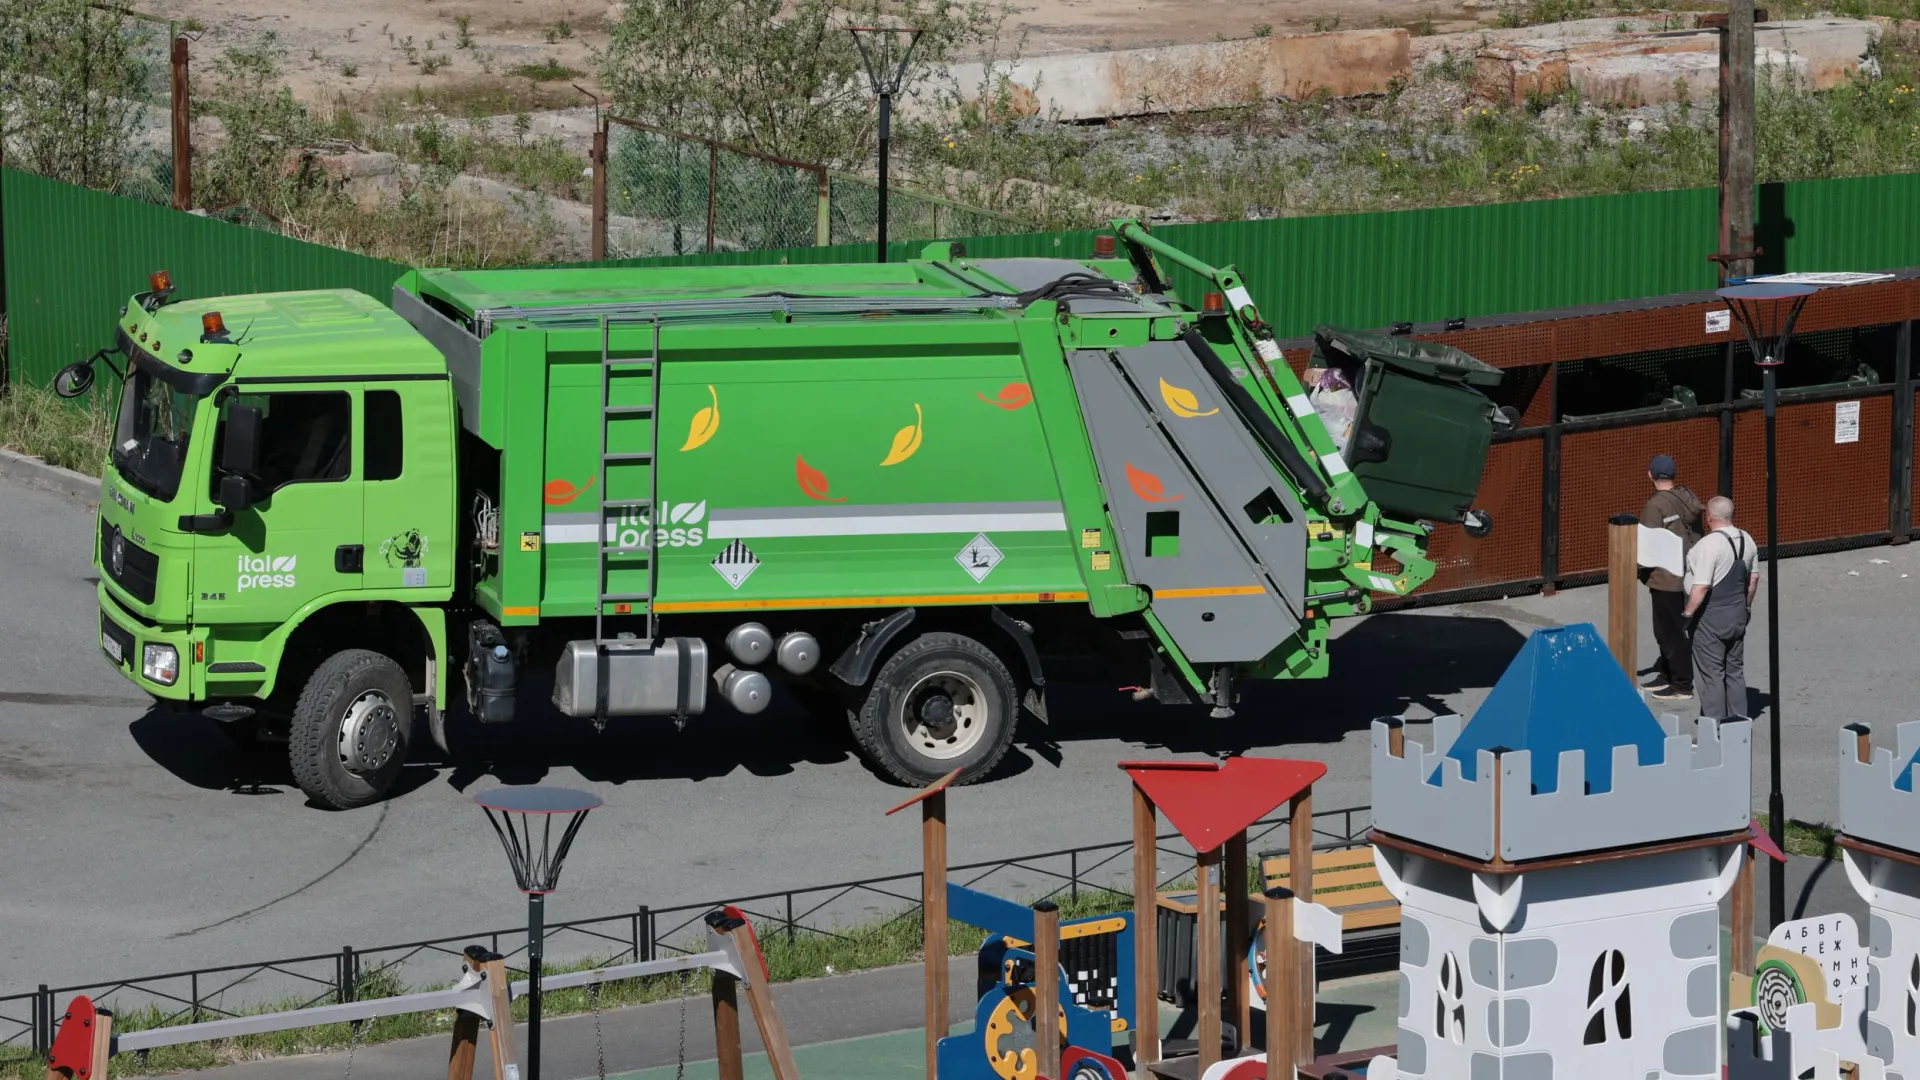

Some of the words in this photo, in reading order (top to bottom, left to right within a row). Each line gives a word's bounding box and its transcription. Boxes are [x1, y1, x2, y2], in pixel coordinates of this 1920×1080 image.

[620, 500, 668, 526] ital
[618, 528, 703, 555] press
[238, 555, 271, 572] ital
[237, 574, 296, 593] press
[1802, 926, 1808, 938] Б
[1836, 920, 1842, 932] Г
[1833, 940, 1842, 951] Ж
[1833, 978, 1841, 988] Ф
